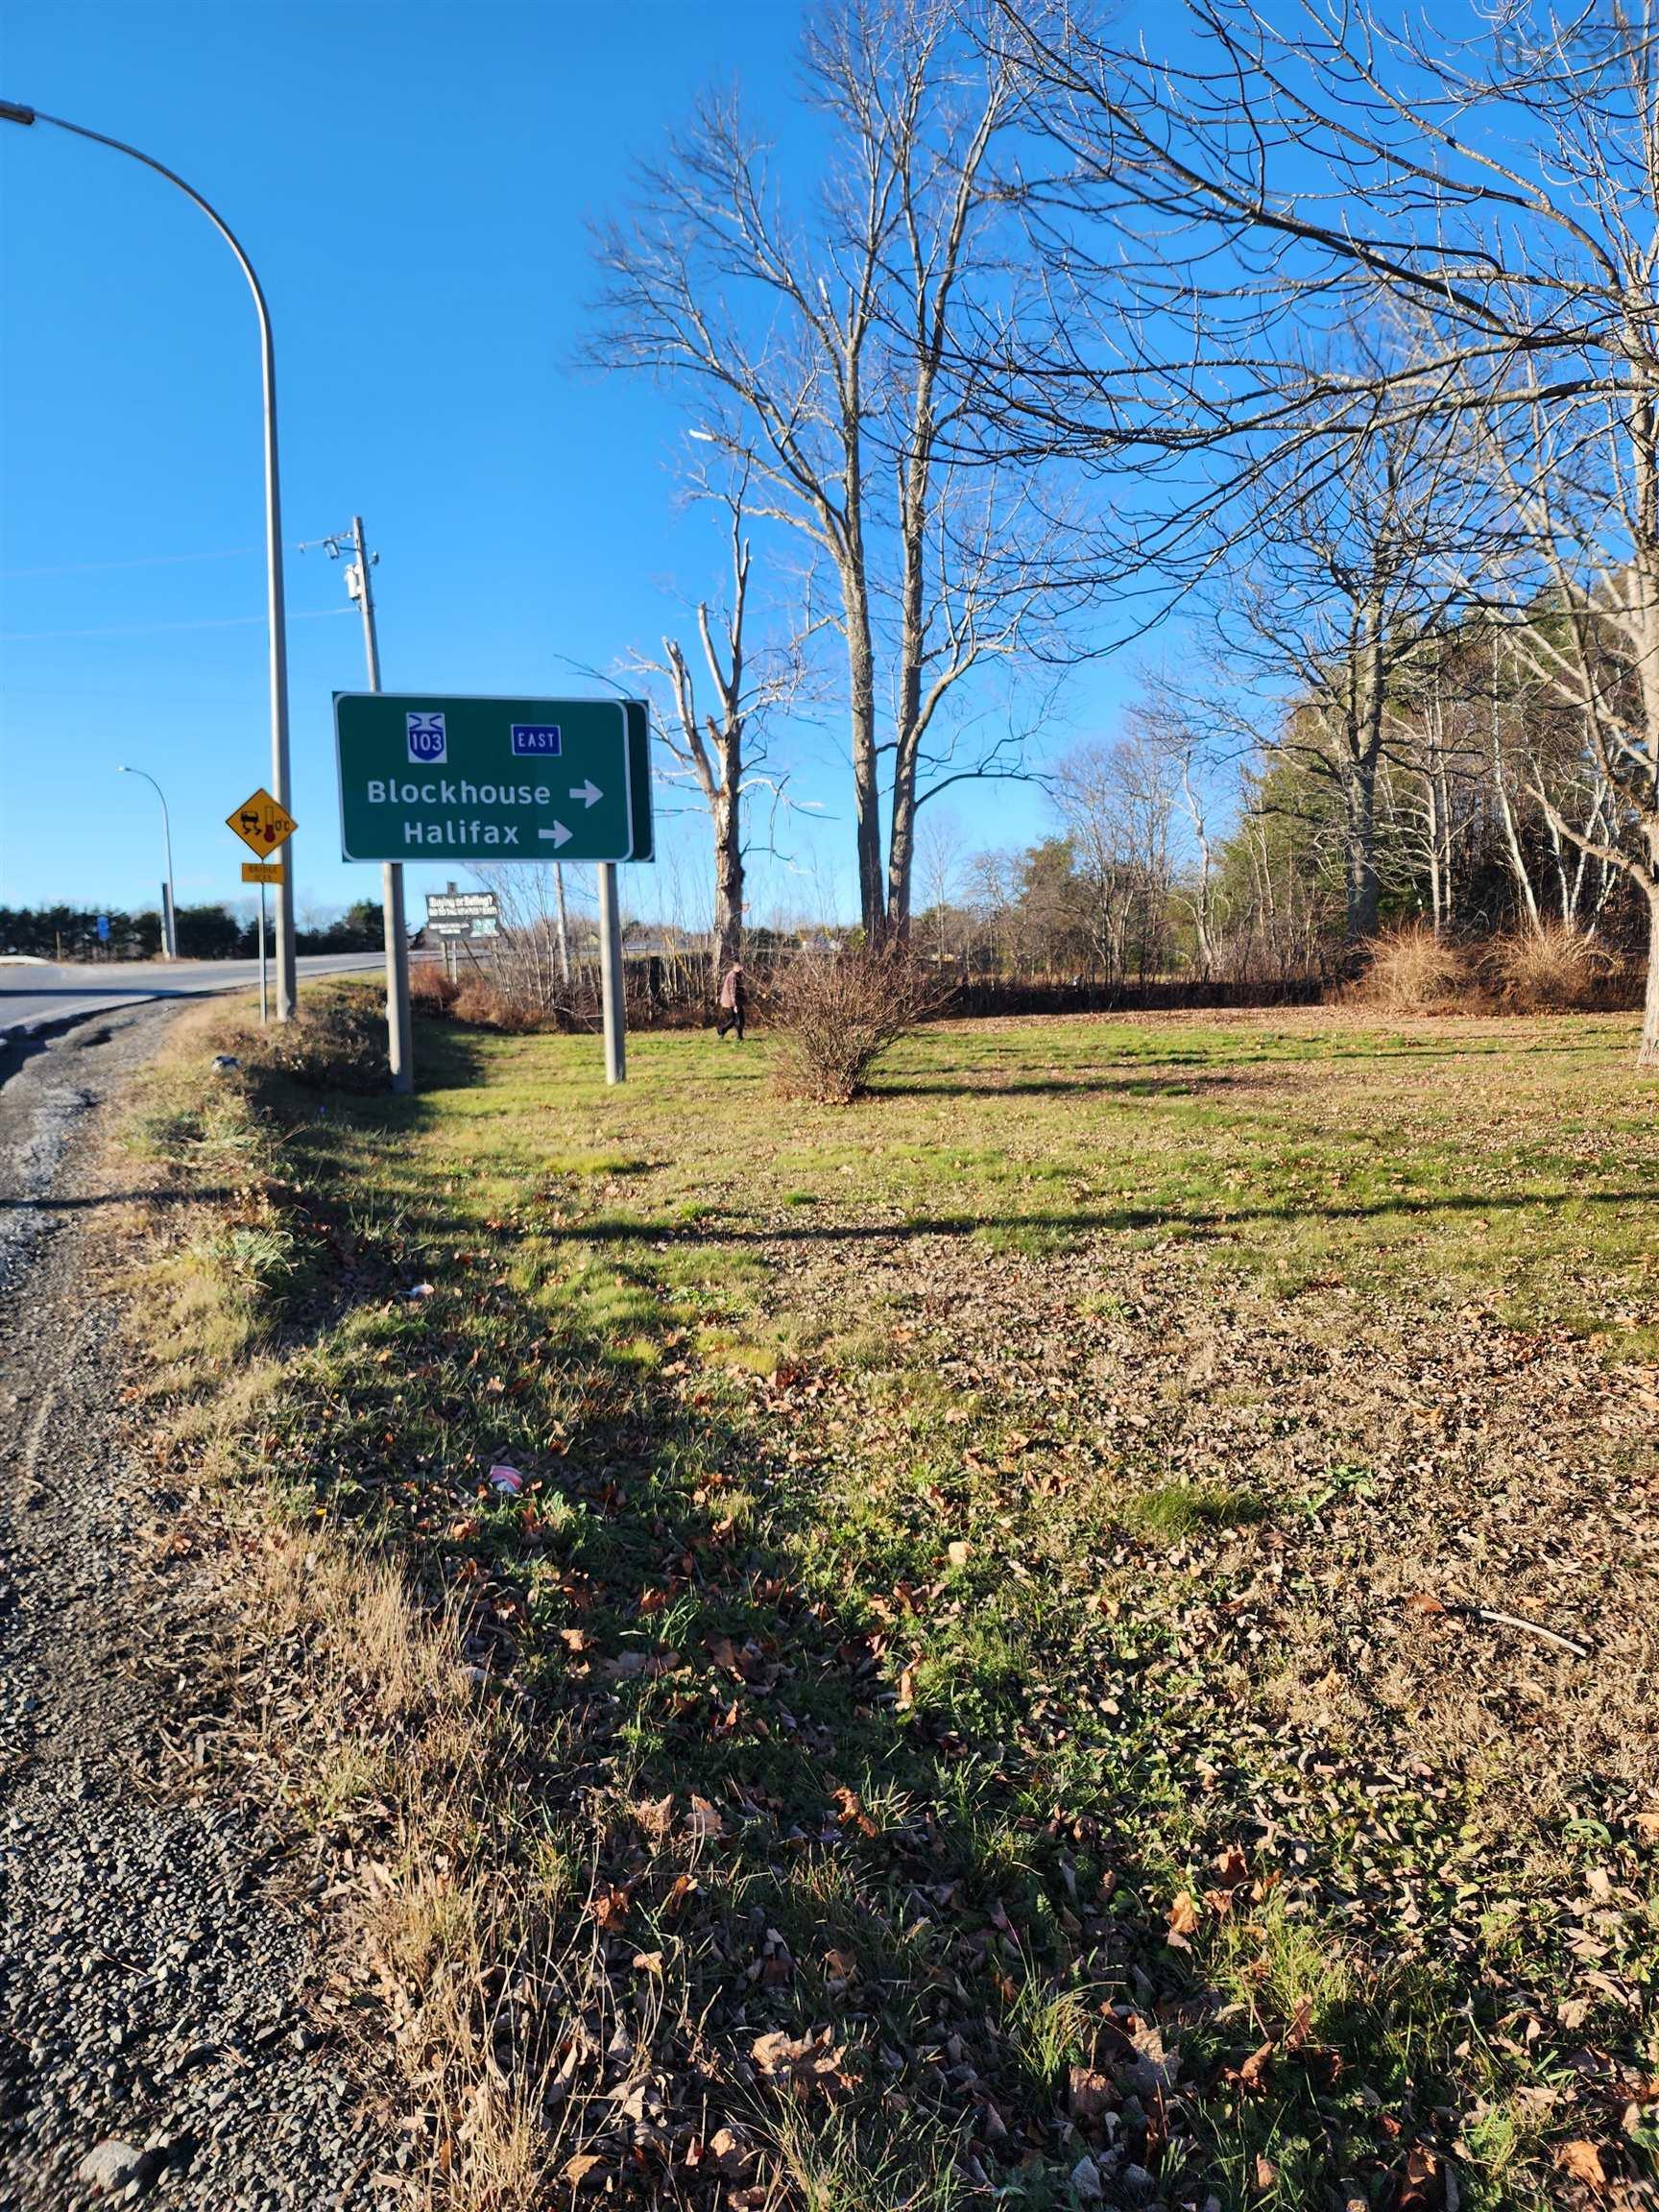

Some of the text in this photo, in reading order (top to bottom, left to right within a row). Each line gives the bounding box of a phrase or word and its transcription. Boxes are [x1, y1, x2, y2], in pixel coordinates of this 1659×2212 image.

[412, 733, 443, 751] 103
[517, 733, 555, 748] EAST
[368, 779, 551, 805] Blockhouse
[404, 820, 519, 845] Halifax
